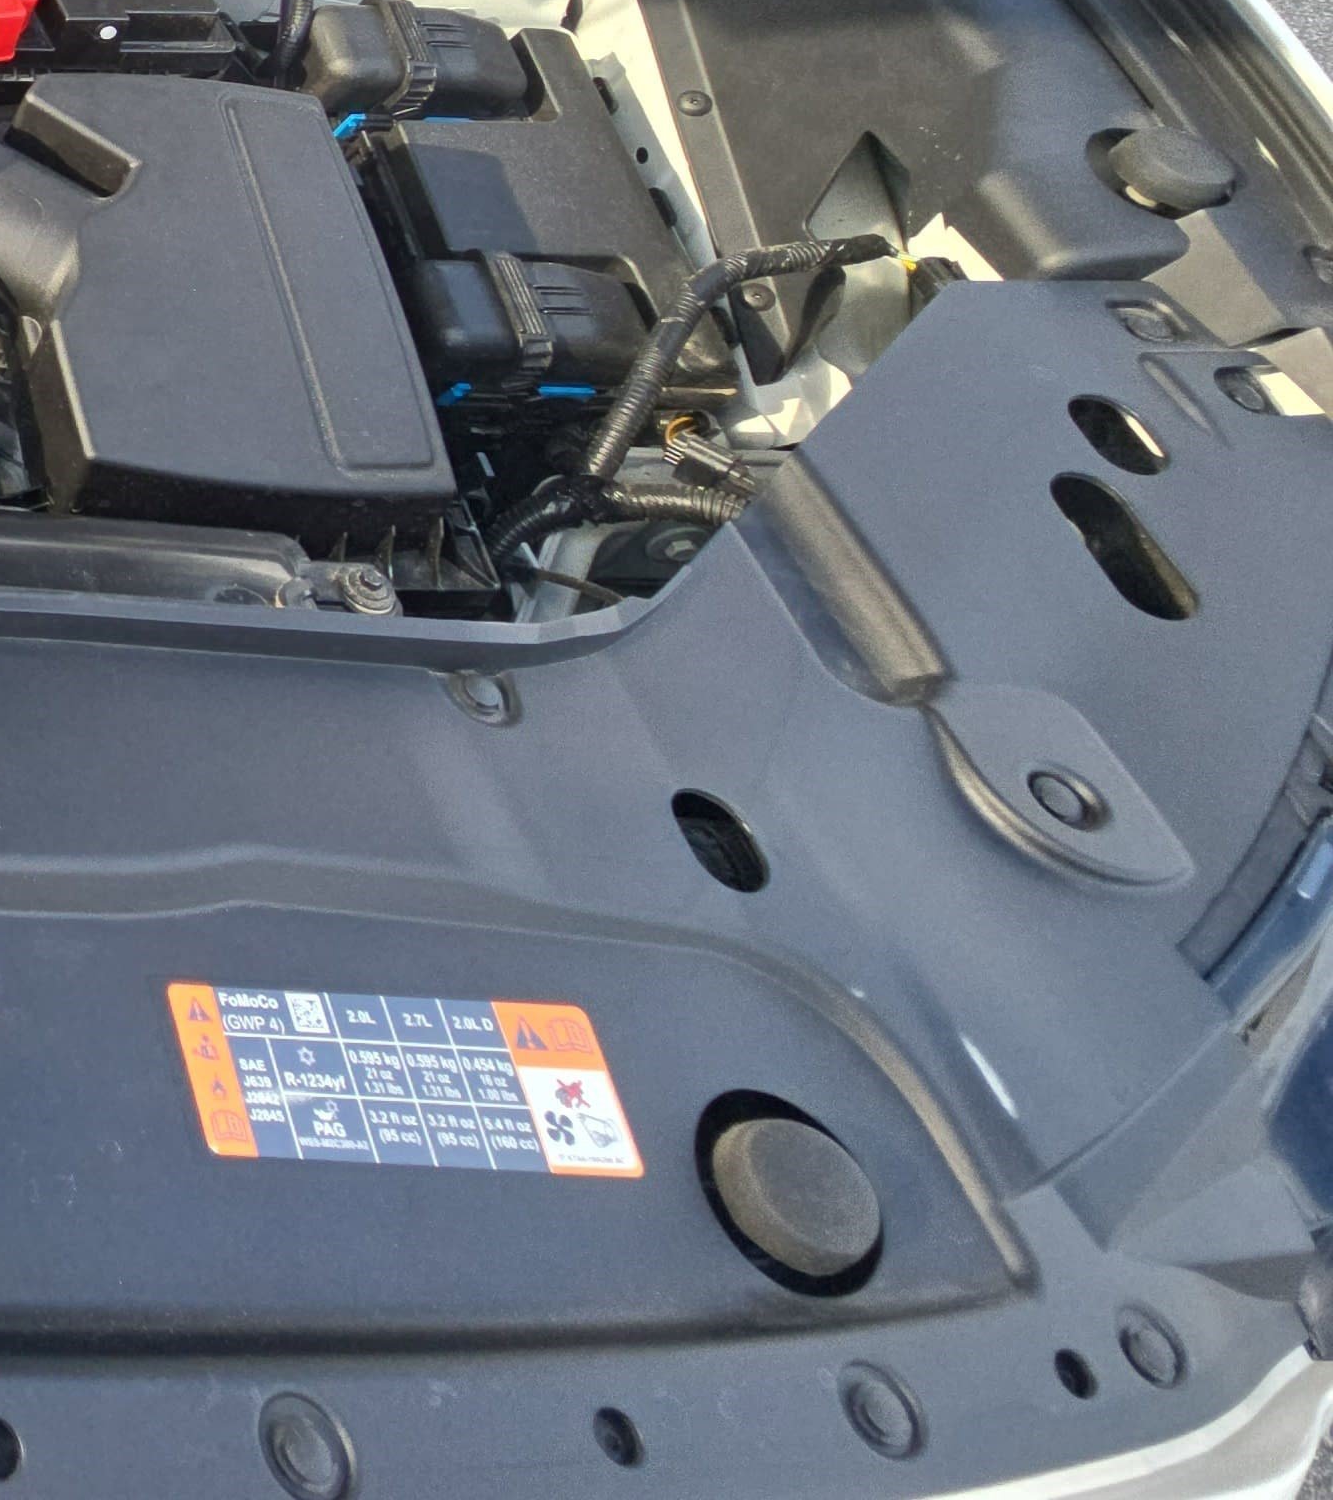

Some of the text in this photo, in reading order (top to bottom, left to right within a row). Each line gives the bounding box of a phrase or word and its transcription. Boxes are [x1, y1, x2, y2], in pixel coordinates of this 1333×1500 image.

[218, 992, 279, 1009] FoMoCo
[223, 1013, 285, 1035] (GWP 4)
[346, 1009, 376, 1024] 2.0L
[402, 1012, 433, 1028] 2.7L
[452, 1016, 494, 1032] 2.0L D
[238, 1058, 267, 1072] SAE
[348, 1049, 401, 1070] 0.595 kg
[405, 1053, 458, 1074] 0.595 kg
[462, 1057, 514, 1077] 0.454 kg
[243, 1075, 272, 1088] J639
[283, 1072, 346, 1092] R-1234yf
[365, 1067, 394, 1081] 21 oz
[423, 1071, 452, 1085] 21 oz
[364, 1082, 384, 1094] 1.31
[493, 1077, 508, 1088] oz
[422, 1085, 442, 1098] 1.31
[369, 1110, 418, 1126] 3.2 fl oz
[426, 1113, 476, 1130] 3.2 fl oz
[484, 1117, 533, 1133] 5.4 fl oz
[313, 1120, 347, 1138] PAG
[378, 1128, 422, 1146] (95 cc)
[437, 1132, 480, 1150] (95 cc)
[491, 1135, 540, 1153] (160 cc)
